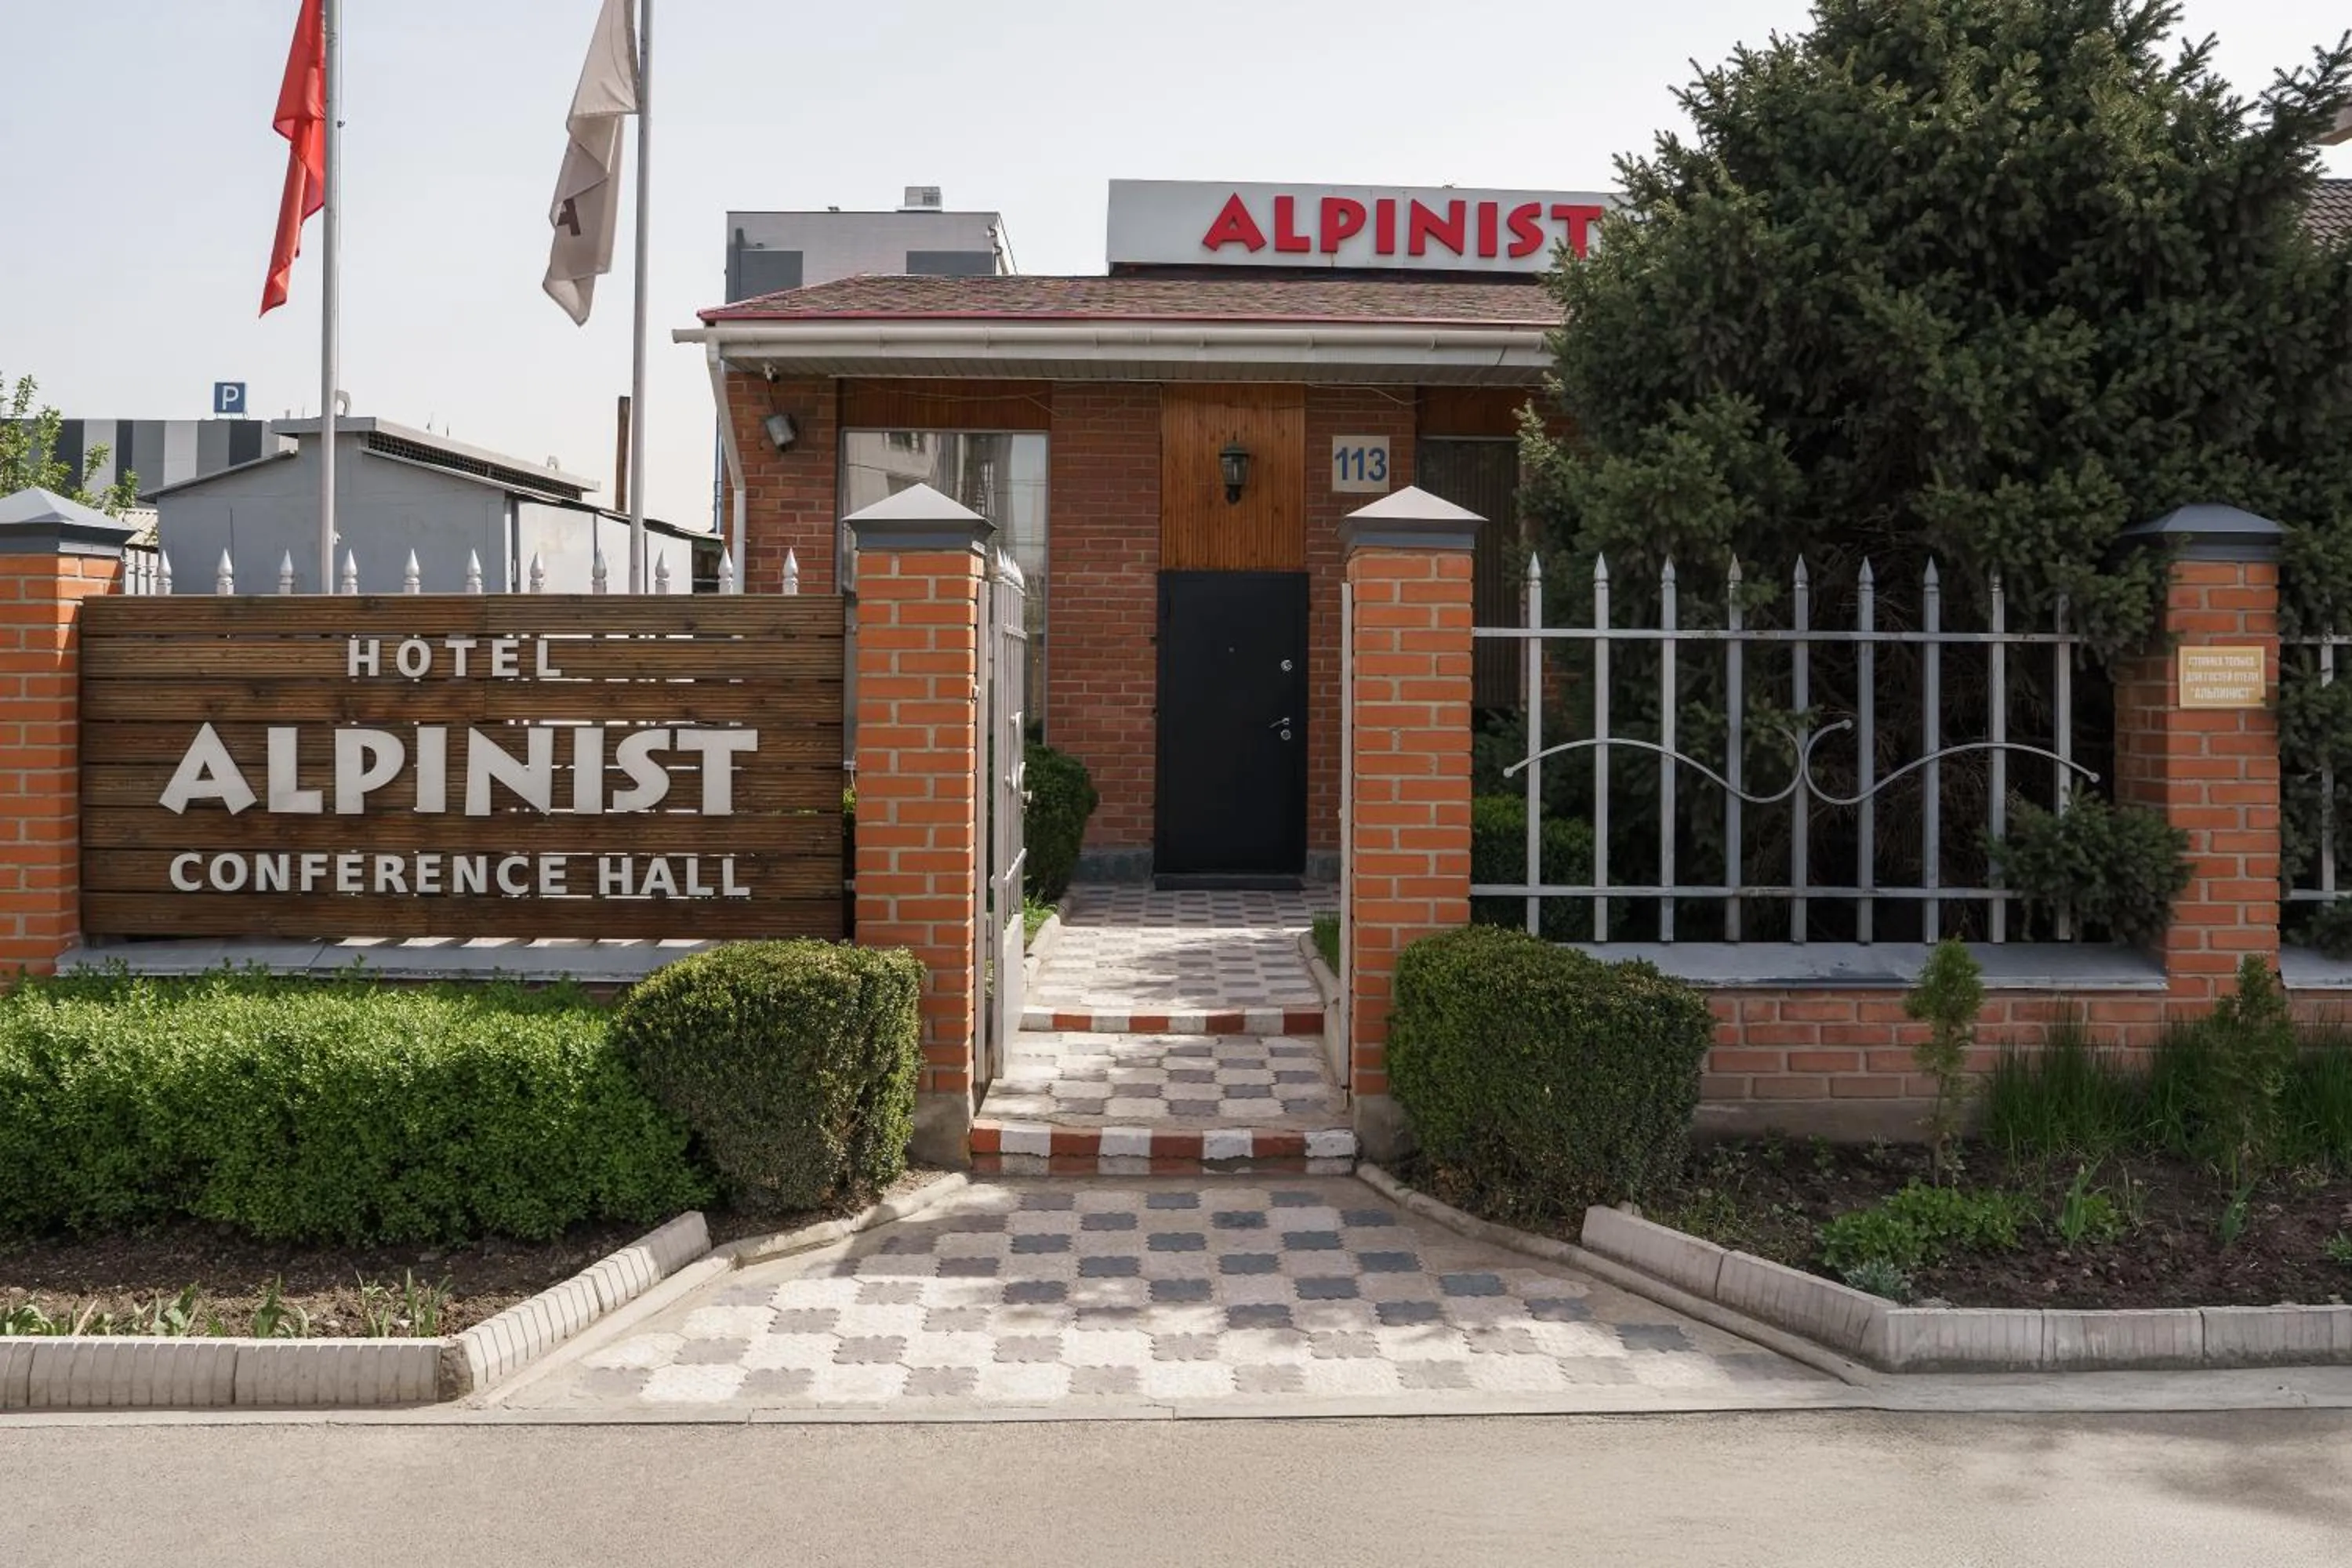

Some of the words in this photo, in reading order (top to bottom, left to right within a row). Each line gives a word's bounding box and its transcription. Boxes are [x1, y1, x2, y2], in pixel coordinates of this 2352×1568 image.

[1203, 192, 1603, 260] ALPINIST
[222, 385, 239, 410] P
[1334, 447, 1386, 481] 113
[347, 639, 562, 677] HOTEL
[159, 721, 758, 816] ALPINIST
[169, 852, 569, 895] CONFERENCE
[597, 855, 751, 897] HALL
